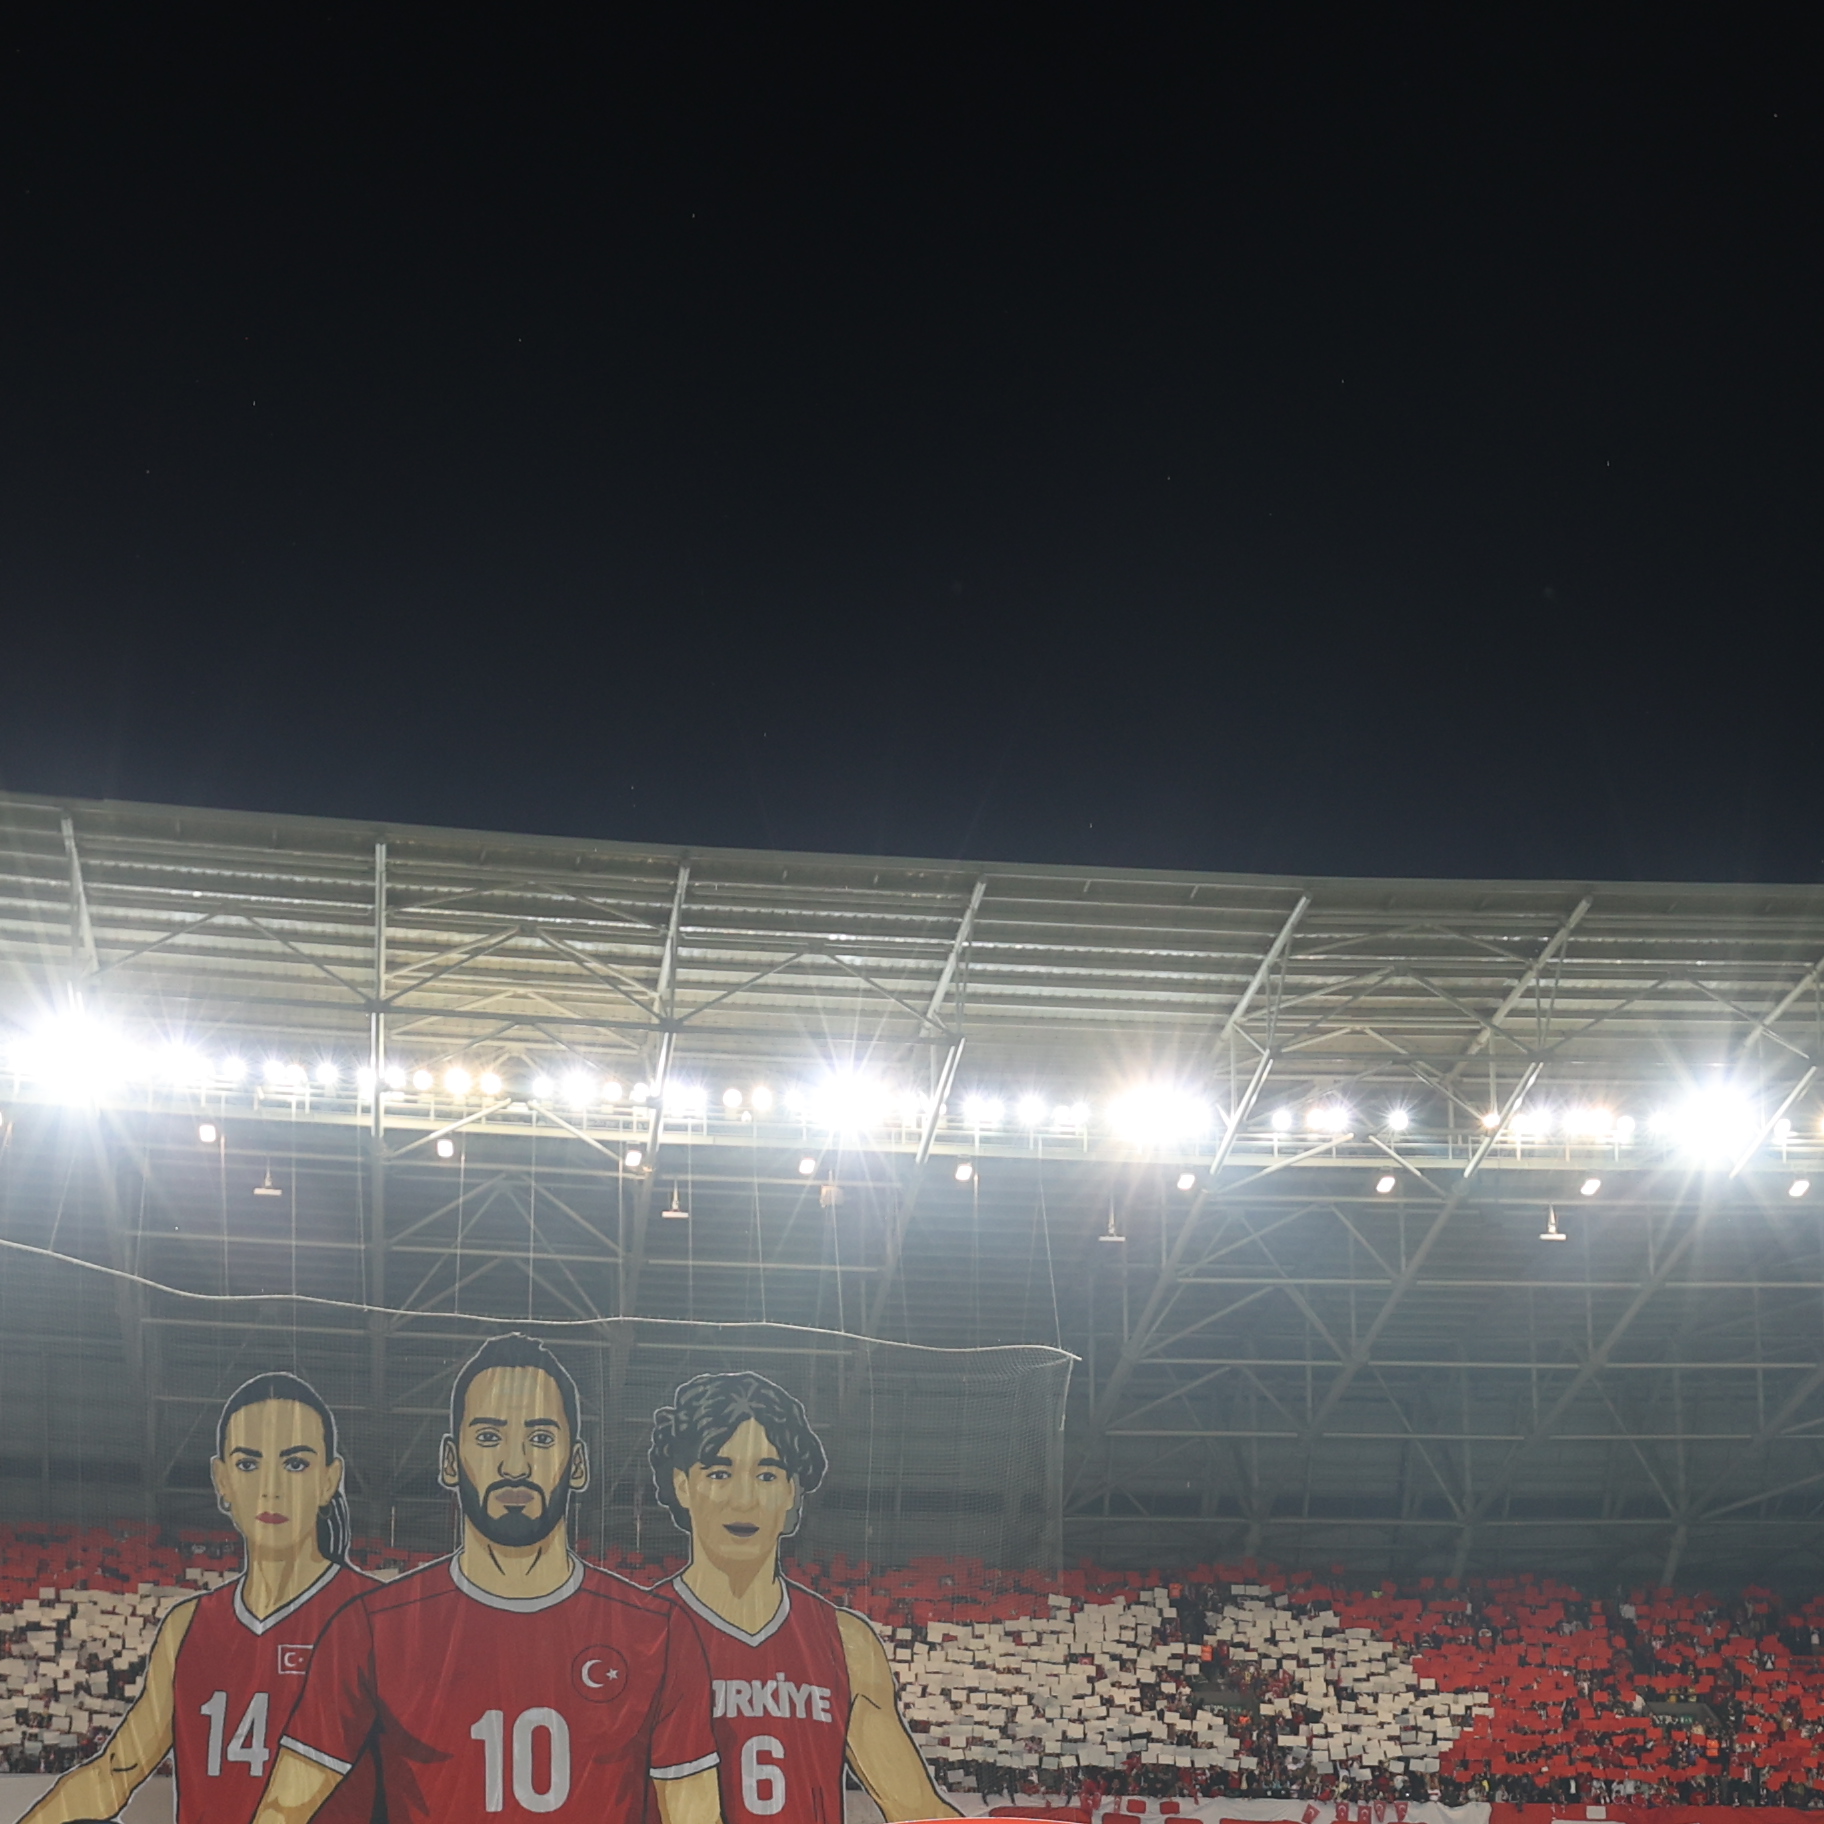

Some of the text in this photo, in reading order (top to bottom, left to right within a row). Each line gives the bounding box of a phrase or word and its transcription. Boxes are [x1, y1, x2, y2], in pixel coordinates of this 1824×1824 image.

[200, 1691, 270, 1777] 14
[713, 1671, 832, 1723] RKİYE
[470, 1707, 572, 1813] 10
[740, 1735, 785, 1815] 6
